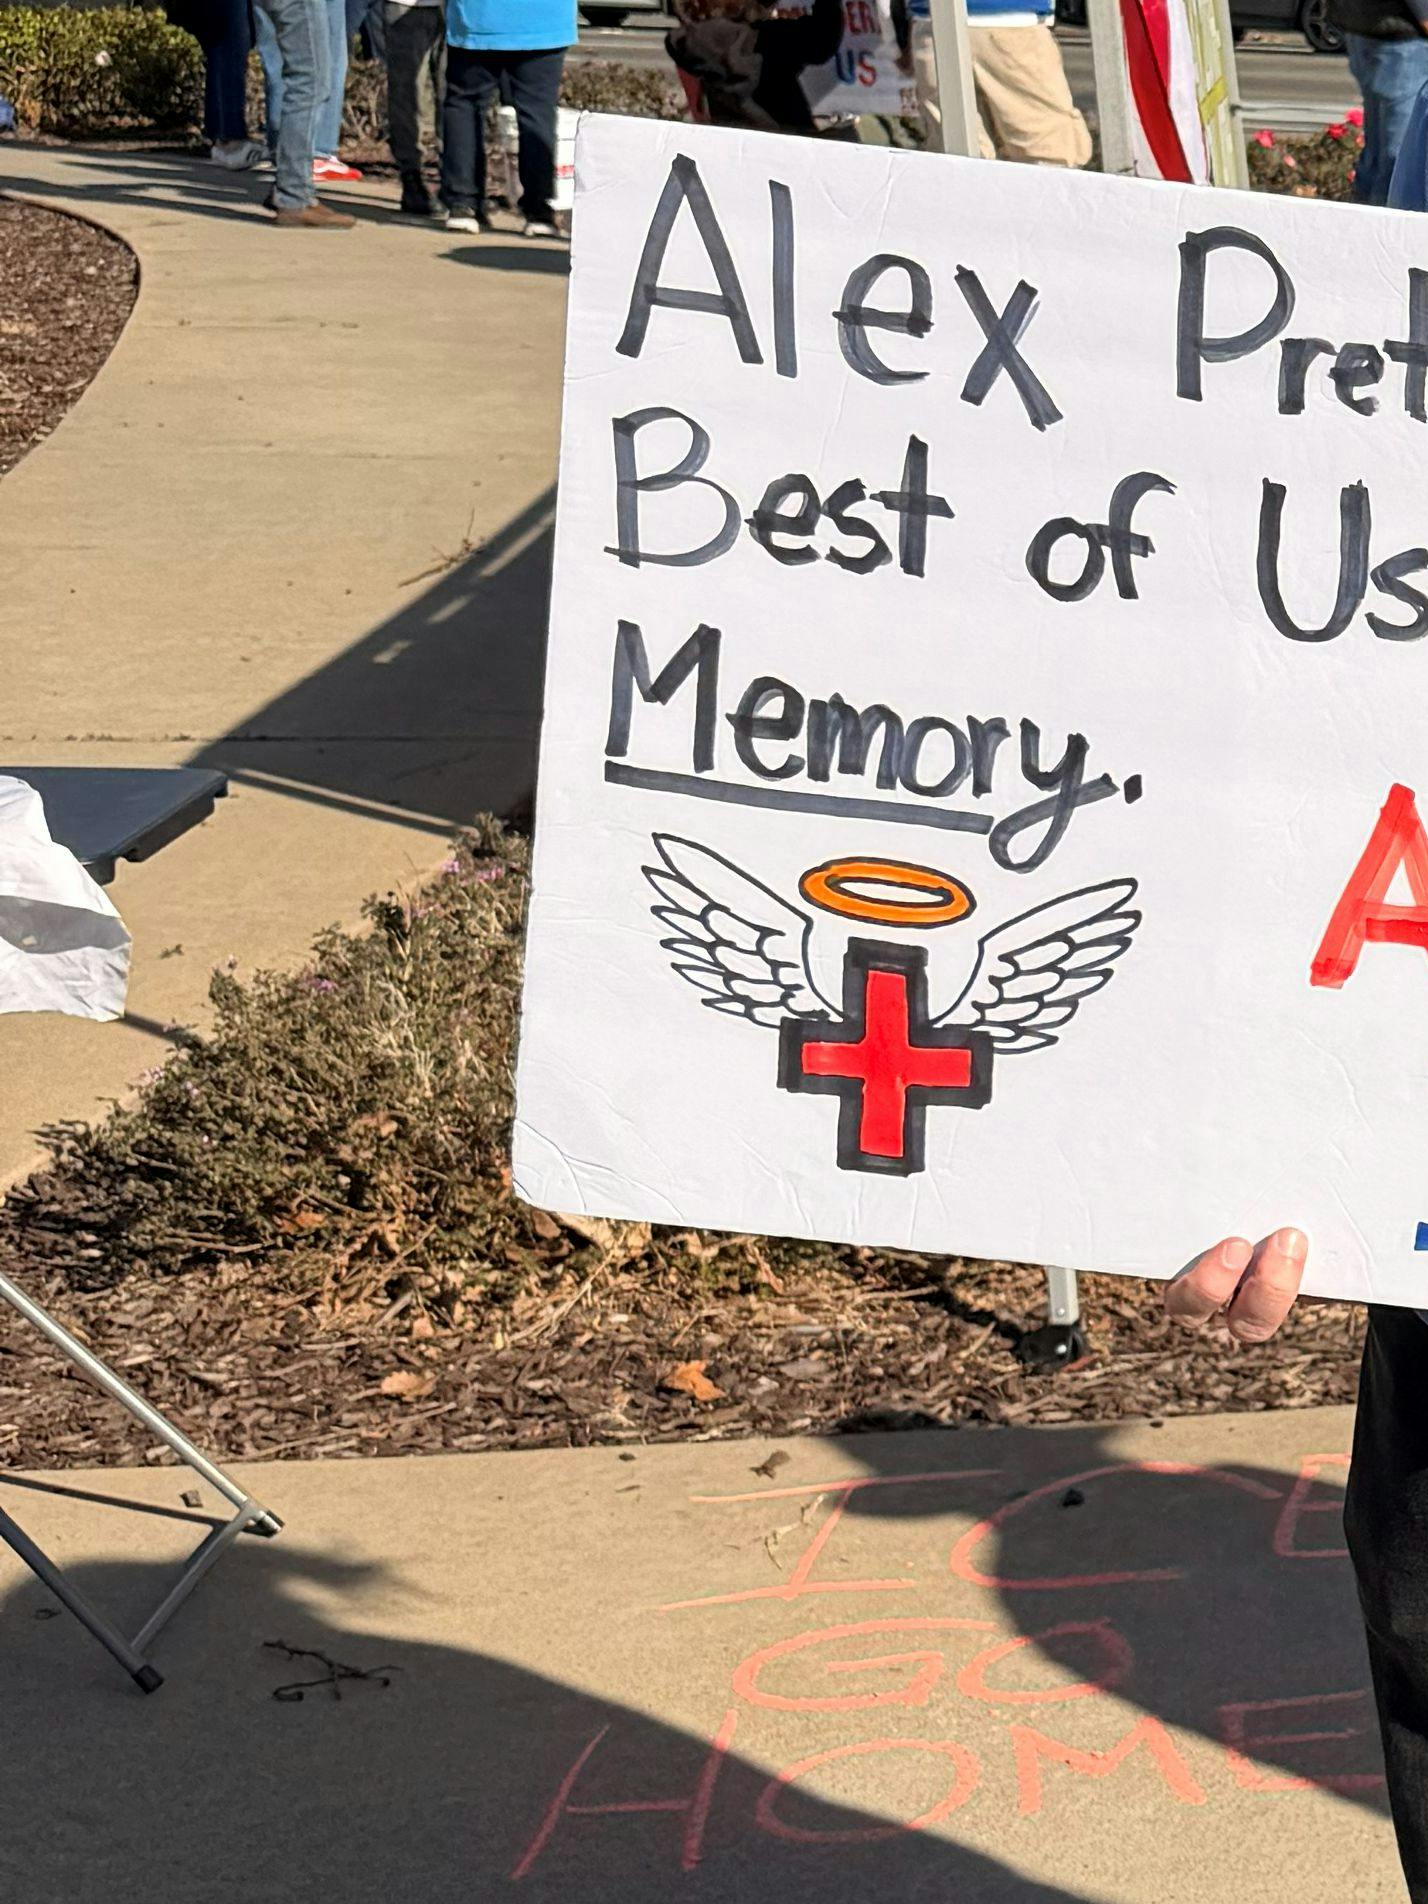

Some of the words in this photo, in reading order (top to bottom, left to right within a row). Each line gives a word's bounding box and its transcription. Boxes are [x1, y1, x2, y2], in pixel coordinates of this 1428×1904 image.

[835, 48, 877, 87] US
[614, 153, 1064, 432] Alex
[602, 406, 957, 580] Best
[1025, 470, 1180, 603] of
[604, 618, 1144, 875] Memory.
[659, 1452, 1352, 1614] ICE
[731, 1616, 1134, 1713] GO
[511, 1690, 1384, 1880] HOME
